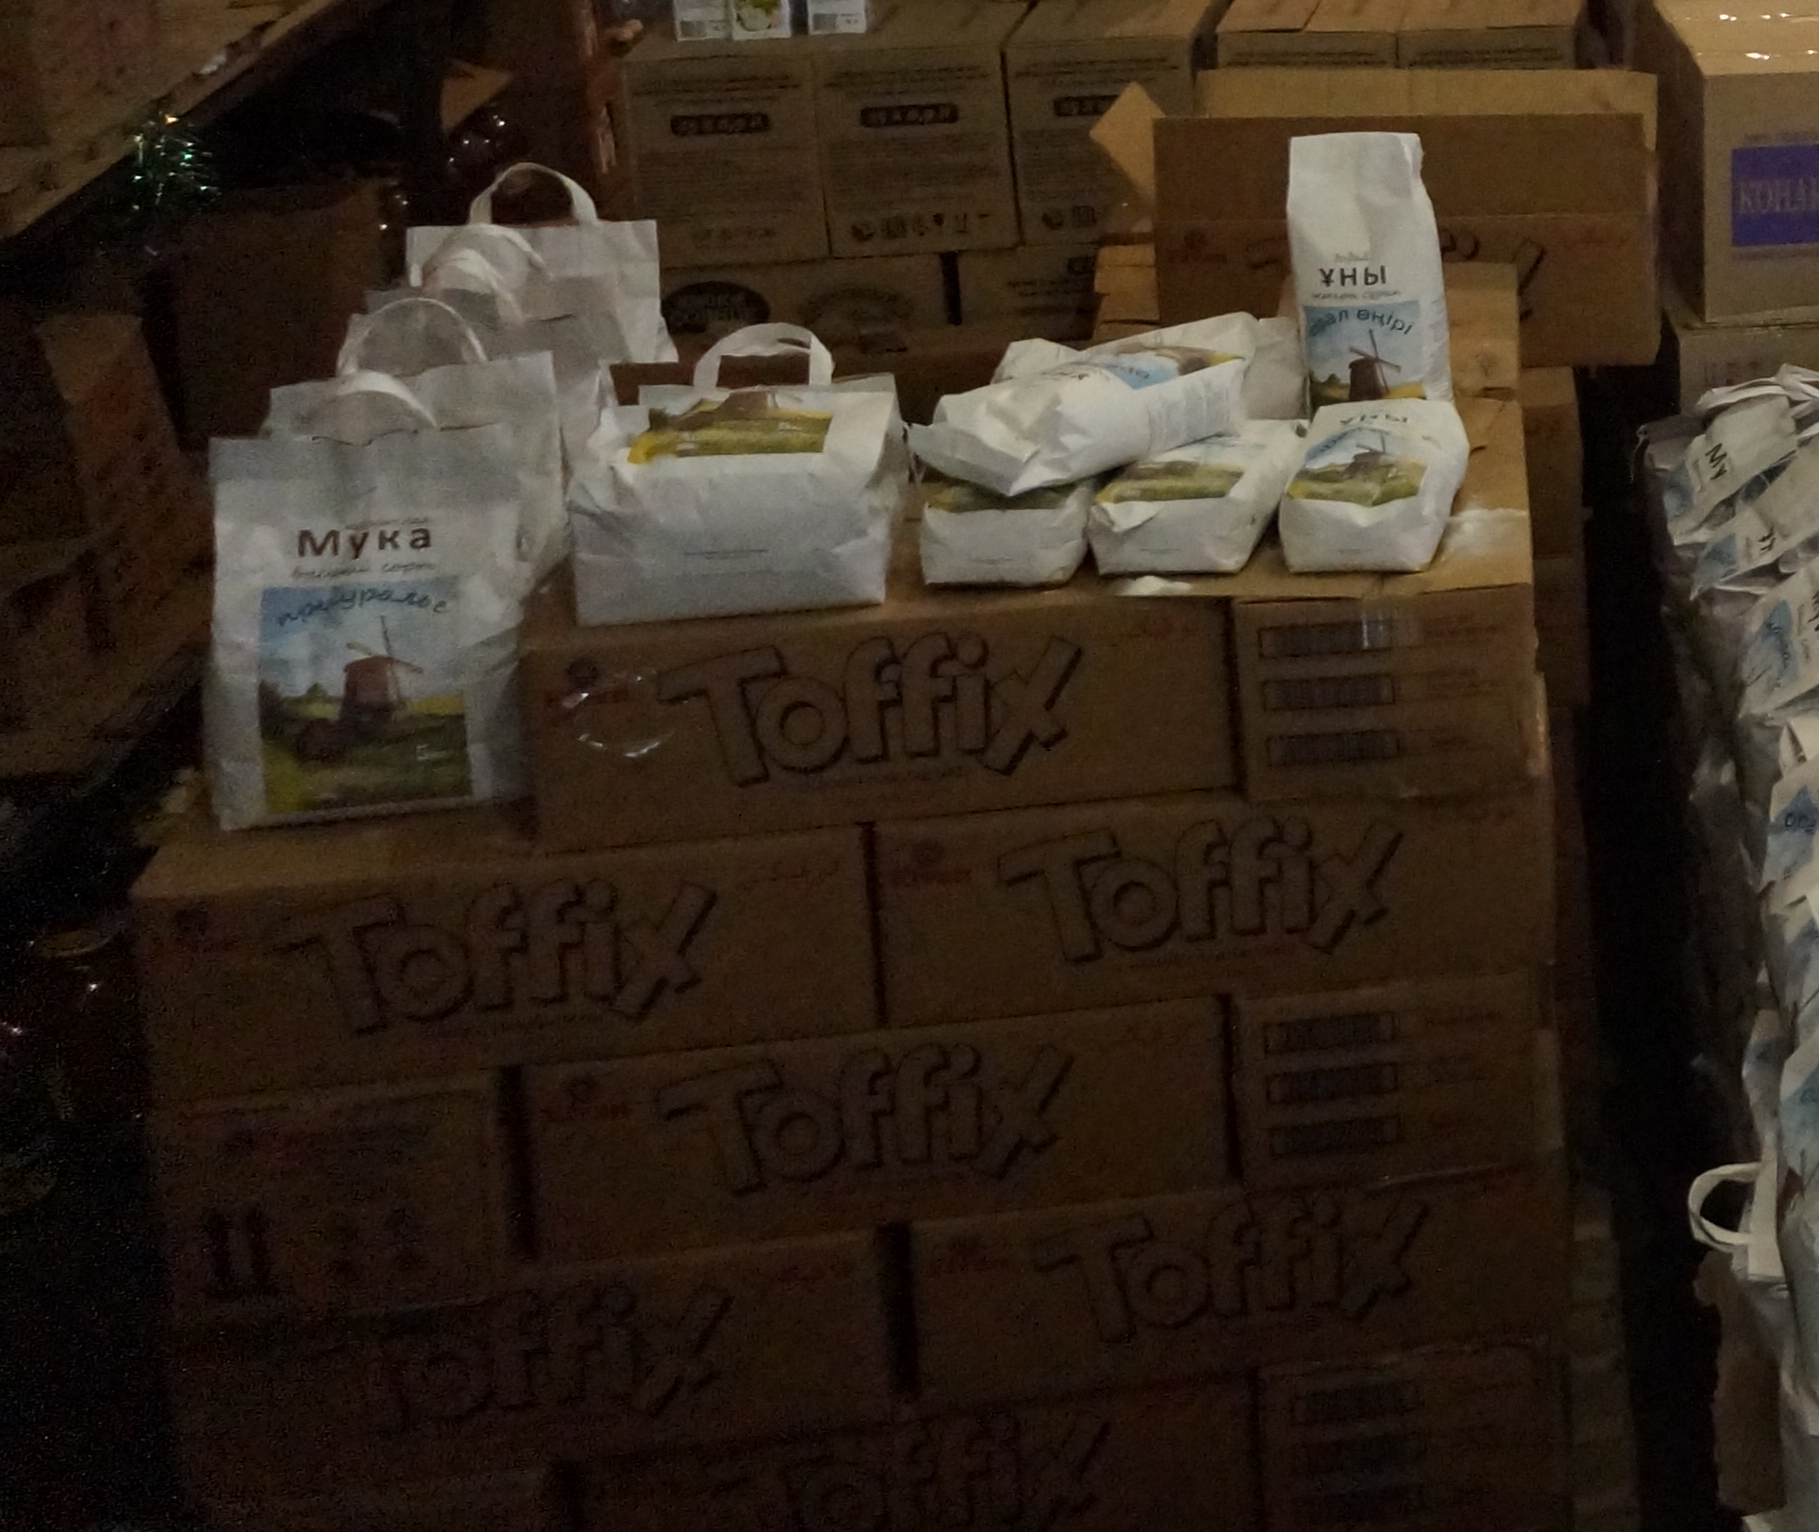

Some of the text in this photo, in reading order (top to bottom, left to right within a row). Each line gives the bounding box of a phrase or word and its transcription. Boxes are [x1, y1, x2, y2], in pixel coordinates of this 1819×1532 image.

[1318, 265, 1388, 288] ҰНЫ
[297, 526, 433, 560] Мука
[658, 633, 1084, 789] Toffix
[280, 878, 719, 1036] Toffix
[998, 814, 1408, 966] Toffix
[658, 1041, 1076, 1200] Toffix
[1032, 1190, 1433, 1348] Toffix
